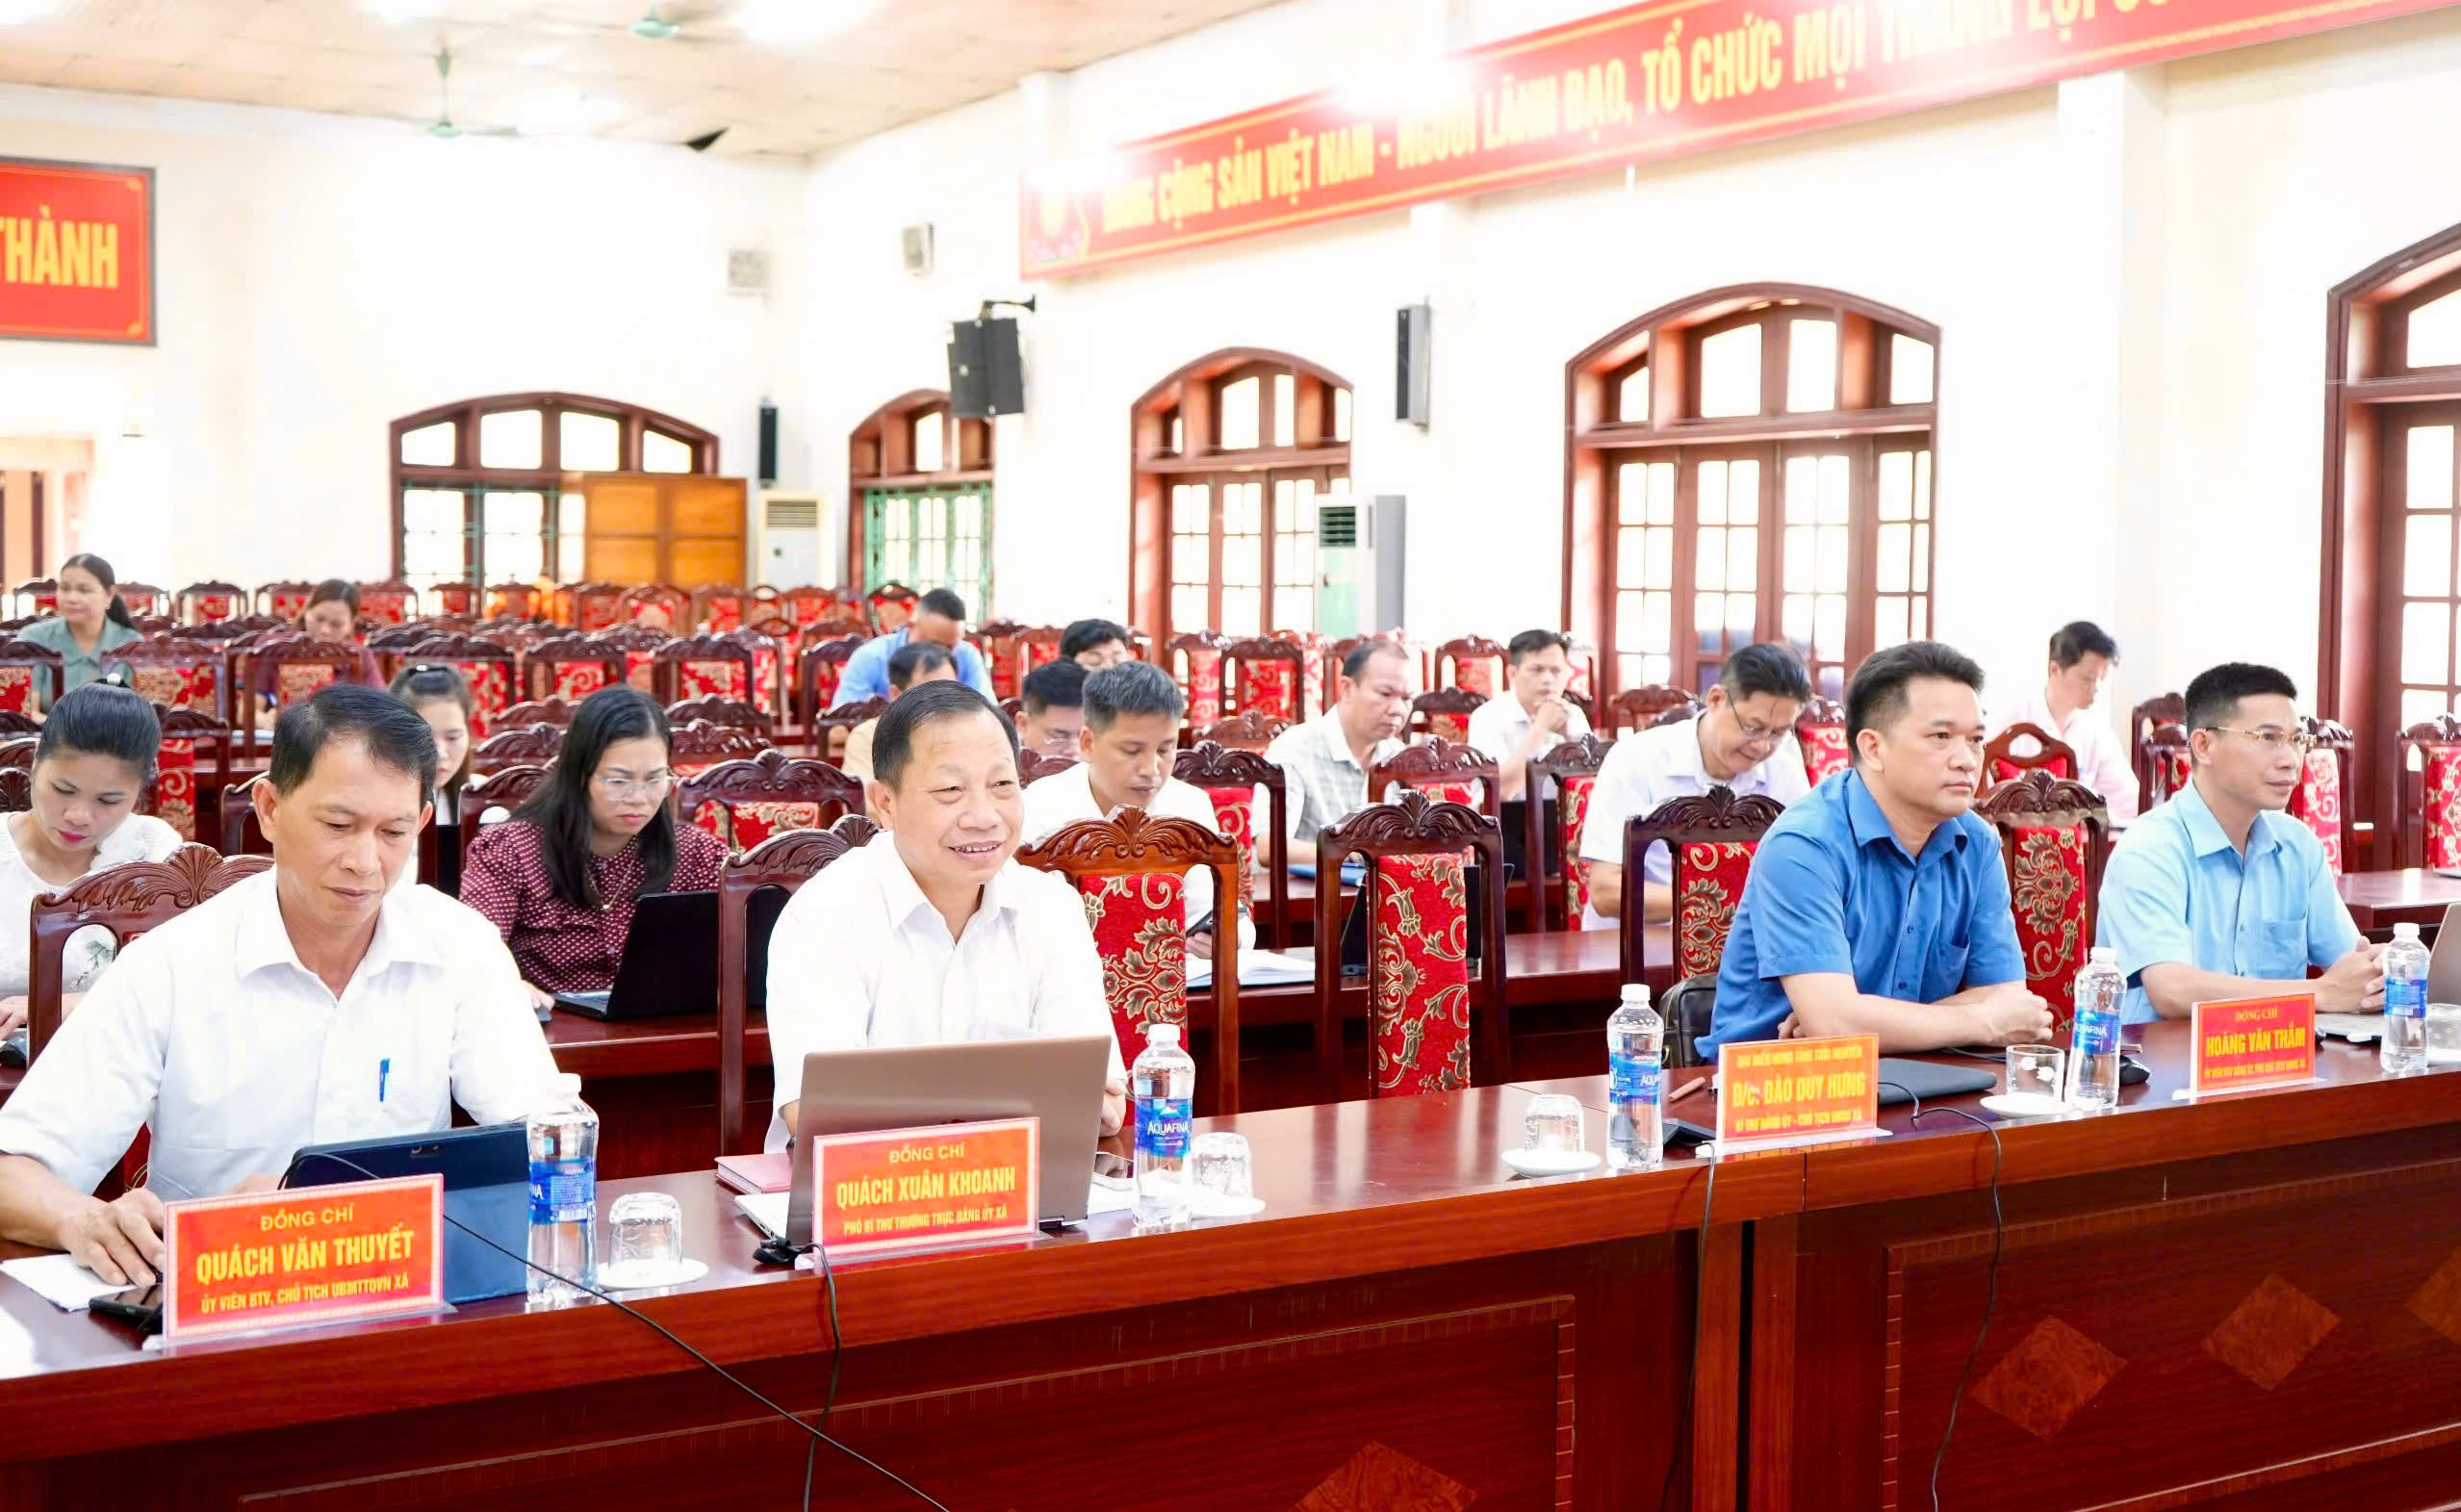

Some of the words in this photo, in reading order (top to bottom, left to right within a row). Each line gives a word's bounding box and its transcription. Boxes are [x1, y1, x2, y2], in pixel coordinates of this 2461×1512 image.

[1266, 127, 1314, 206] VIỆT
[1318, 122, 1374, 188] NAM
[1641, 17, 1682, 115] TỔ
[1690, 11, 1782, 106] CHỨC
[1793, 1, 1866, 90] MỌI
[0, 204, 118, 289] HÀNH
[2206, 1031, 2245, 1057] HOÀNG
[2248, 1027, 2271, 1052] VĂN
[1796, 1076, 1825, 1101] DUY
[1146, 1120, 1189, 1136] AQUAFINA
[889, 1143, 934, 1164] ĐỒNG
[938, 1140, 966, 1159] CHÍ
[835, 1175, 894, 1210] QUÁCH
[898, 1169, 944, 1202] XUÂN
[949, 1166, 1015, 1197] KHOANH
[260, 1208, 316, 1233] ĐỒNG
[320, 1203, 355, 1224] CHÍ
[195, 1241, 274, 1285] QUÁCH
[281, 1236, 327, 1272] VĂN
[333, 1222, 415, 1268] THUYẾT
[201, 1293, 218, 1315] ỦY
[219, 1291, 247, 1311] VIÊN
[248, 1288, 274, 1309] BTV,
[277, 1282, 301, 1304] CHỦ
[303, 1282, 329, 1306] TỊCH
[331, 1275, 393, 1299] UBMTTQVN
